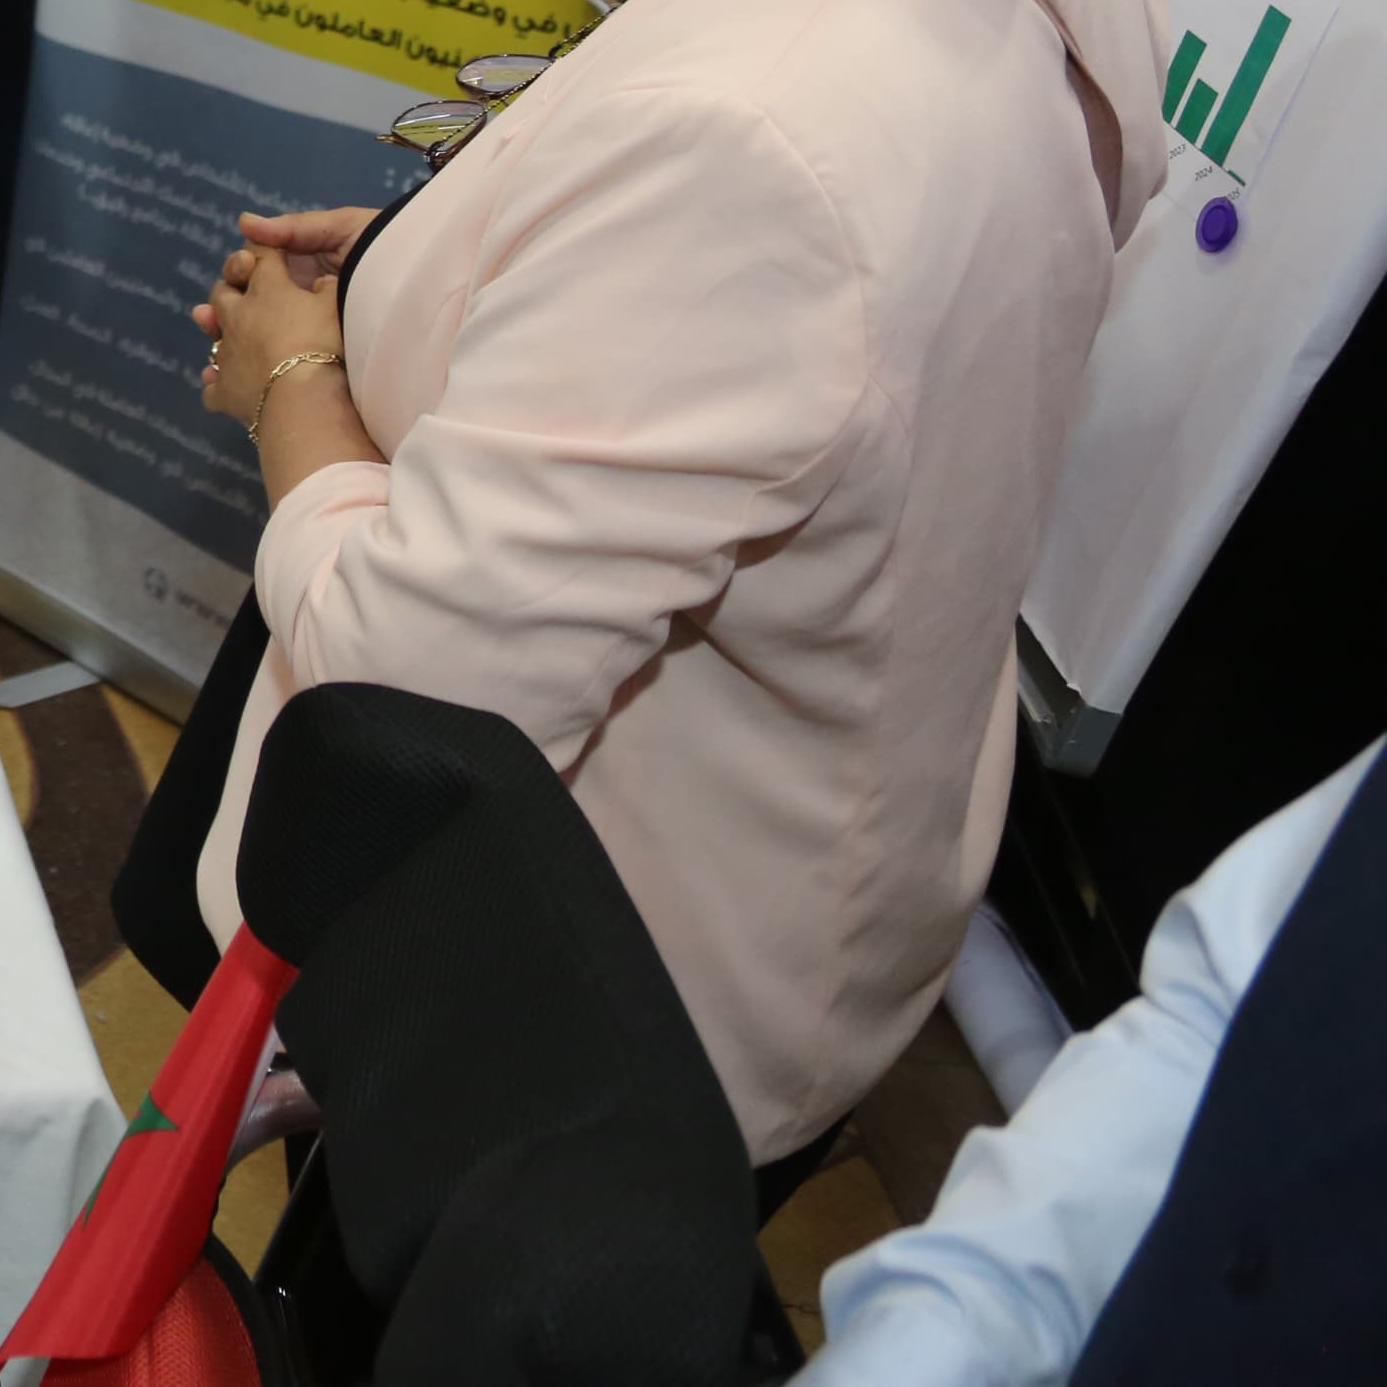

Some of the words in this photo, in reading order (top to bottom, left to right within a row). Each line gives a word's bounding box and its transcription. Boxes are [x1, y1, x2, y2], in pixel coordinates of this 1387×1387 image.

[293, 5, 404, 51] العاملون
[512, 12, 560, 40] في
[1168, 143, 1187, 160] 2023
[1194, 165, 1213, 182] 2024
